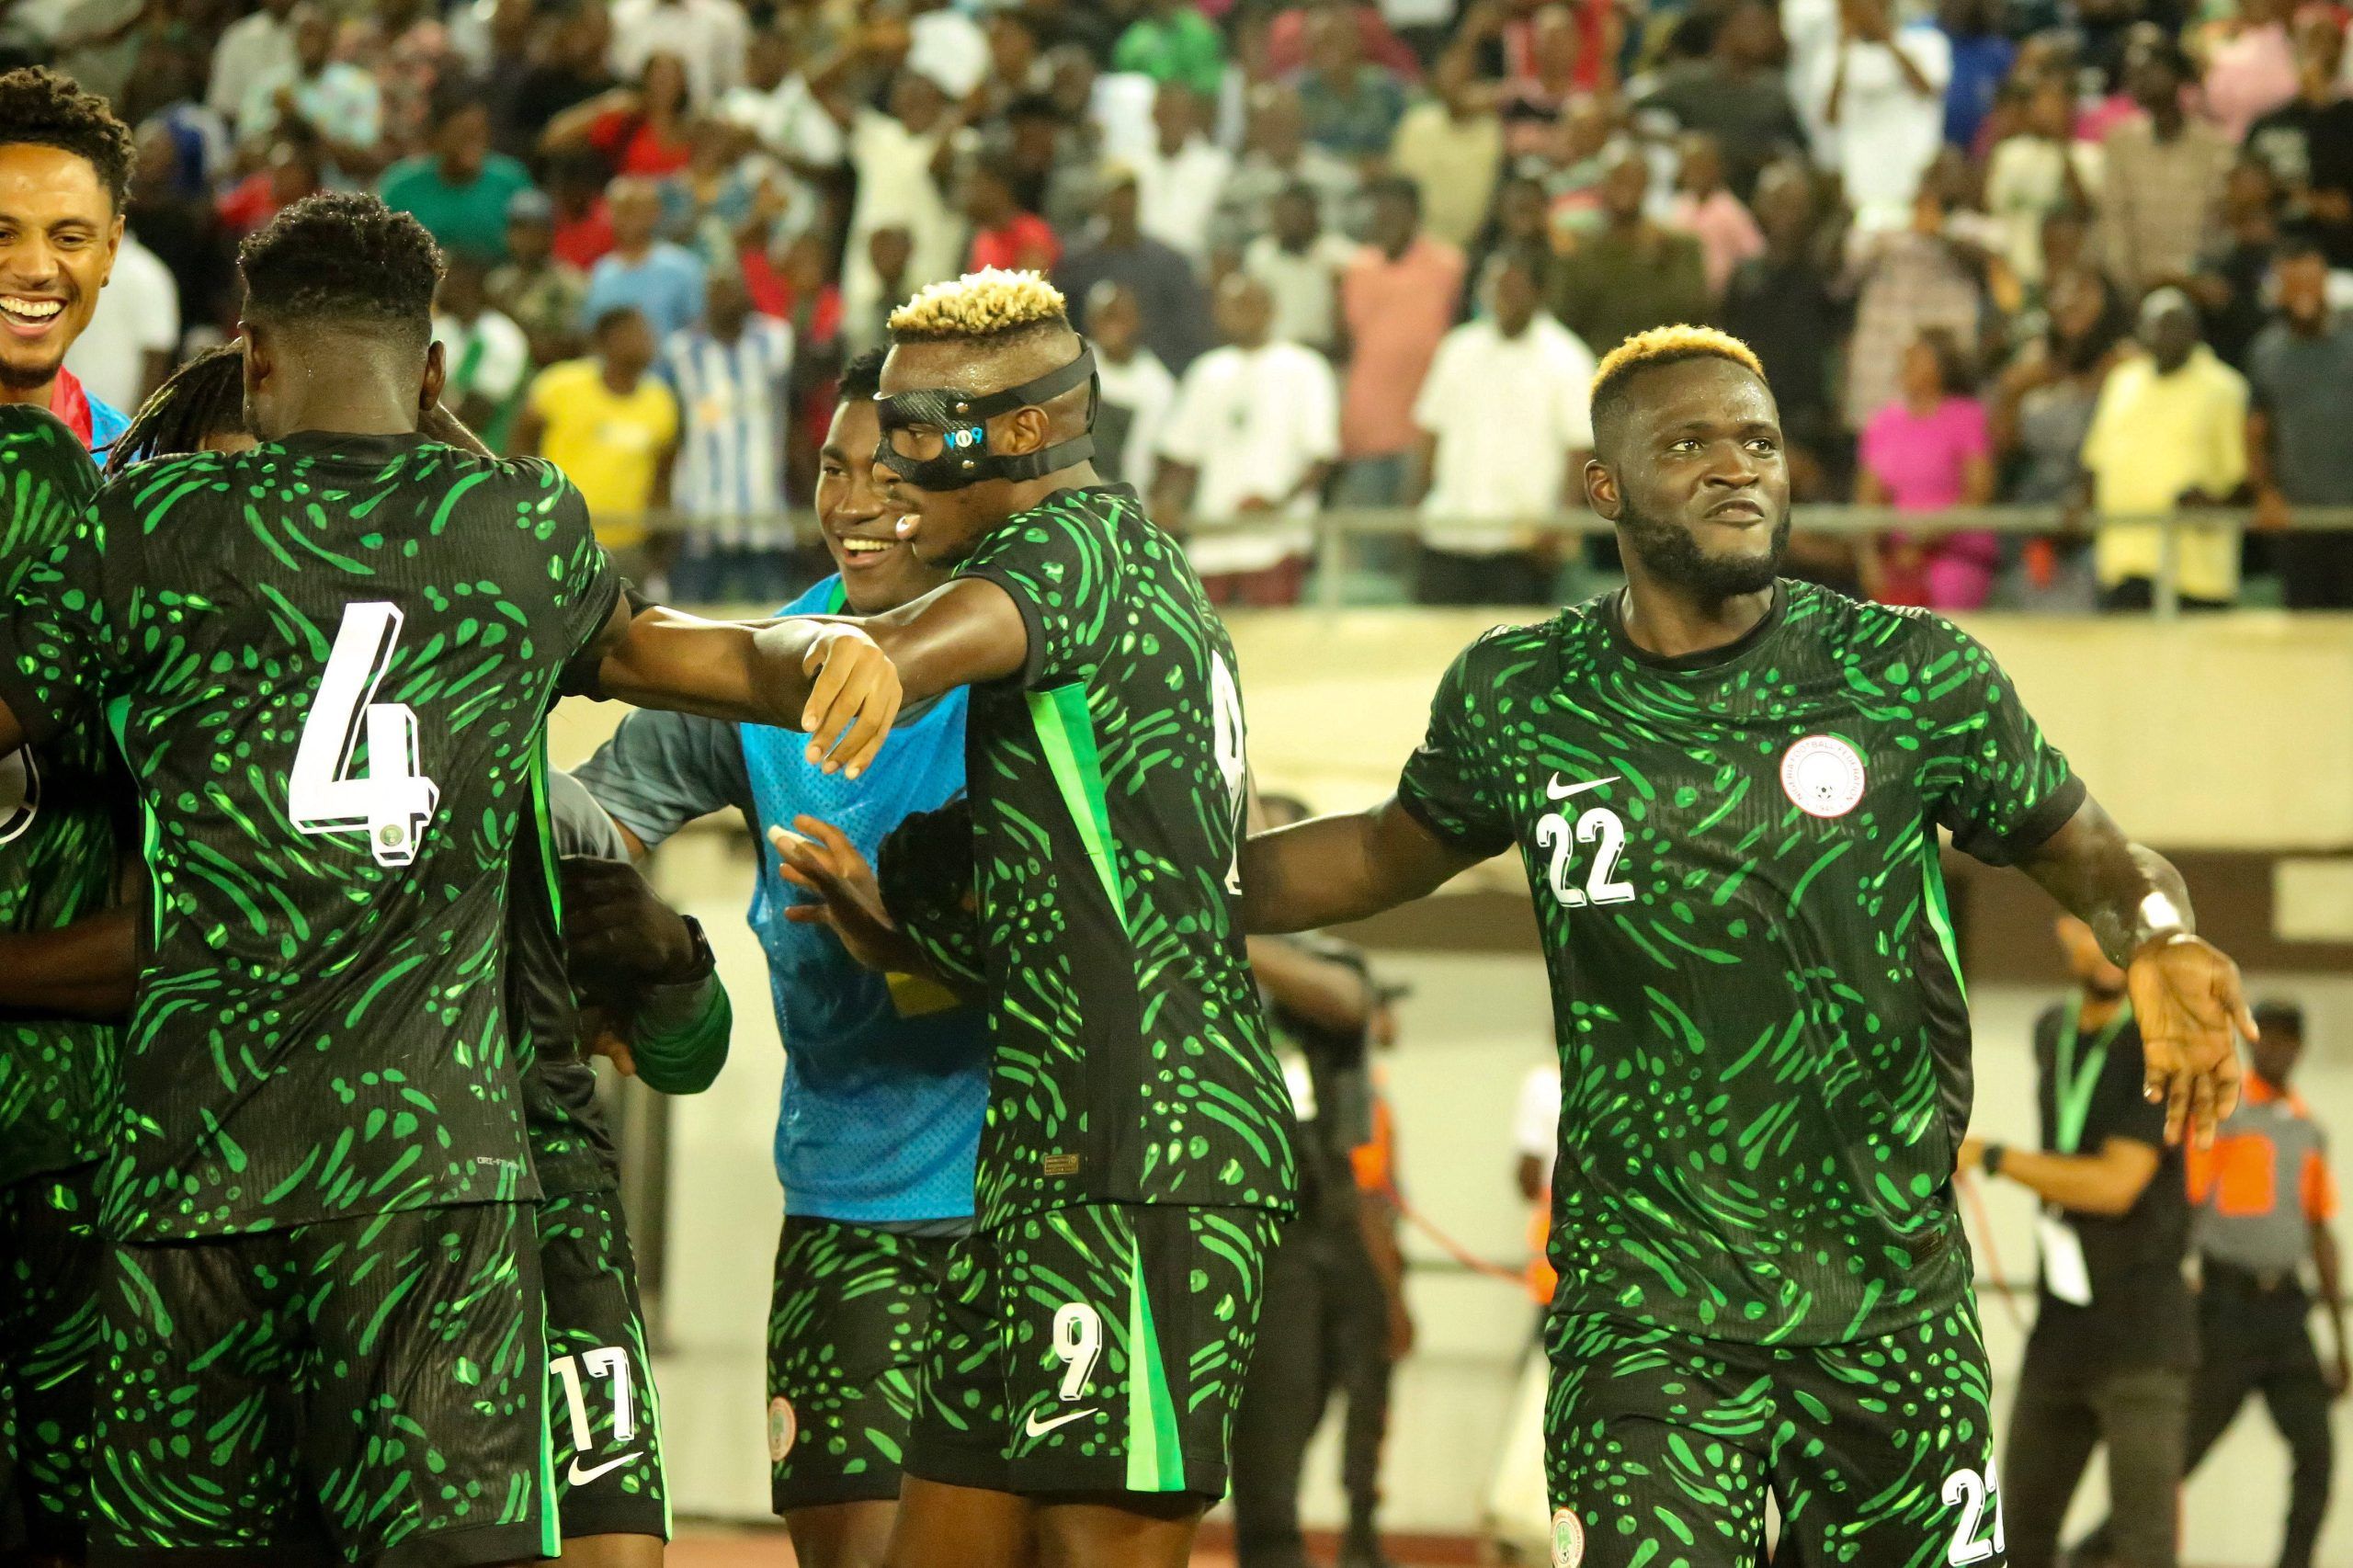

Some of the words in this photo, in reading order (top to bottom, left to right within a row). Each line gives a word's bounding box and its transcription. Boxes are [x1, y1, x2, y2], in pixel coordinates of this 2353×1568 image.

[289, 602, 439, 866] 4
[1536, 807, 1635, 907] 22
[549, 1346, 634, 1452] 17
[1052, 1302, 1102, 1402] 9
